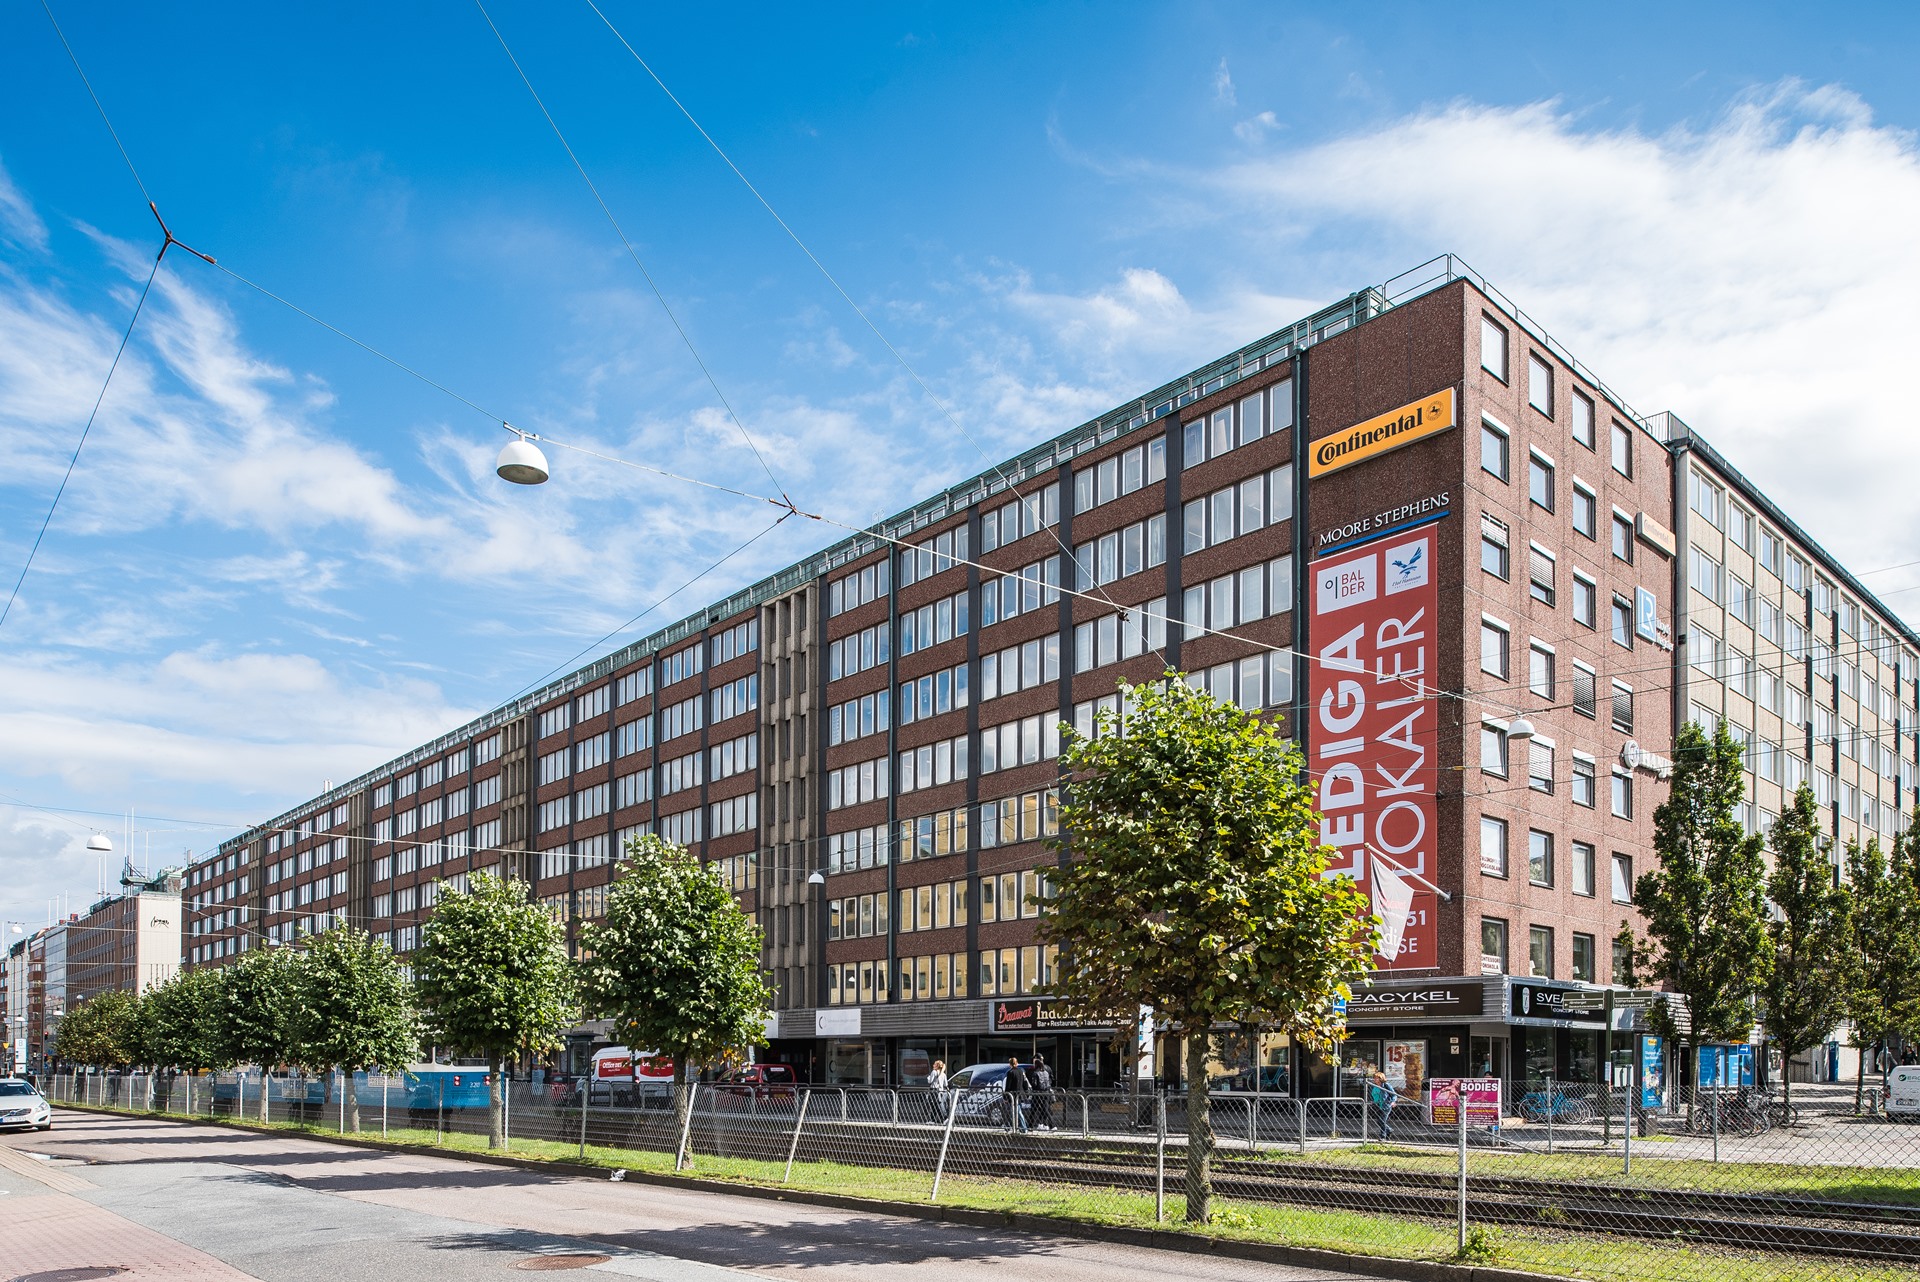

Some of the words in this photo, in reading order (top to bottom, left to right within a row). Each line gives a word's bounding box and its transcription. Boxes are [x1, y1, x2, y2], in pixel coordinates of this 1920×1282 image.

[1317, 408, 1423, 466] Continental
[1320, 518, 1370, 546] MOORE
[1375, 492, 1449, 526] STEPHENS
[1341, 570, 1364, 585] BAL
[1341, 580, 1365, 598] DER
[1376, 606, 1425, 877] LOKALER
[1319, 622, 1365, 881] LEDIGA
[1348, 991, 1459, 1003] EACYKEL
[1387, 1046, 1402, 1062] 15
[1460, 1083, 1498, 1091] BODIES
